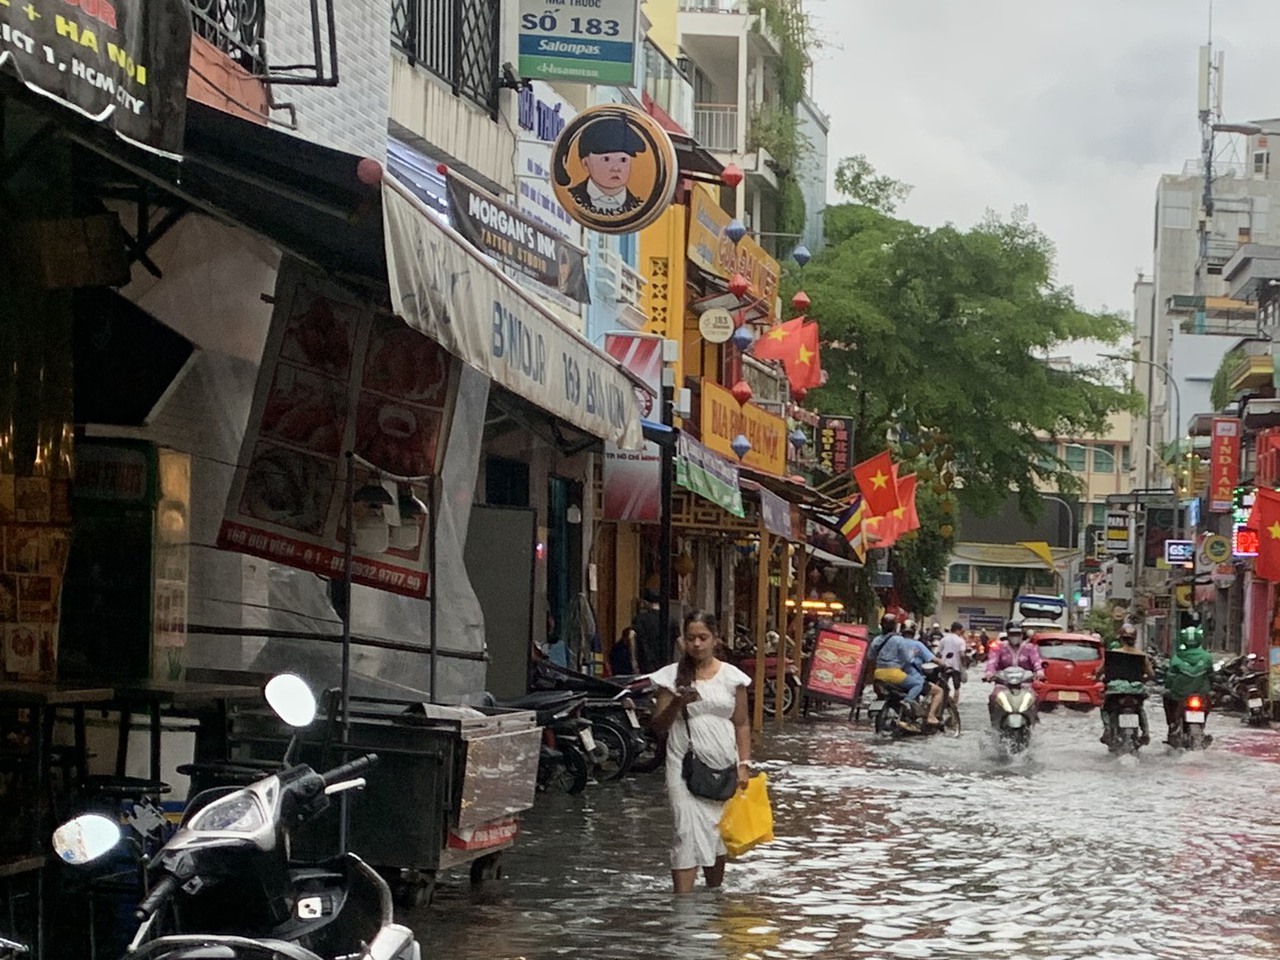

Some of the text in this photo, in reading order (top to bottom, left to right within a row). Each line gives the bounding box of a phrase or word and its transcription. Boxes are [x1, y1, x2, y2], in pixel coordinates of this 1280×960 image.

[521, 9, 620, 37] SỐ 183
[538, 39, 600, 55] Salonpas
[0, 22, 35, 54] ICT
[72, 57, 116, 94] HCM
[469, 192, 534, 248] MORGAN'S
[536, 230, 556, 261] INK
[1218, 436, 1232, 495] INDIAN
